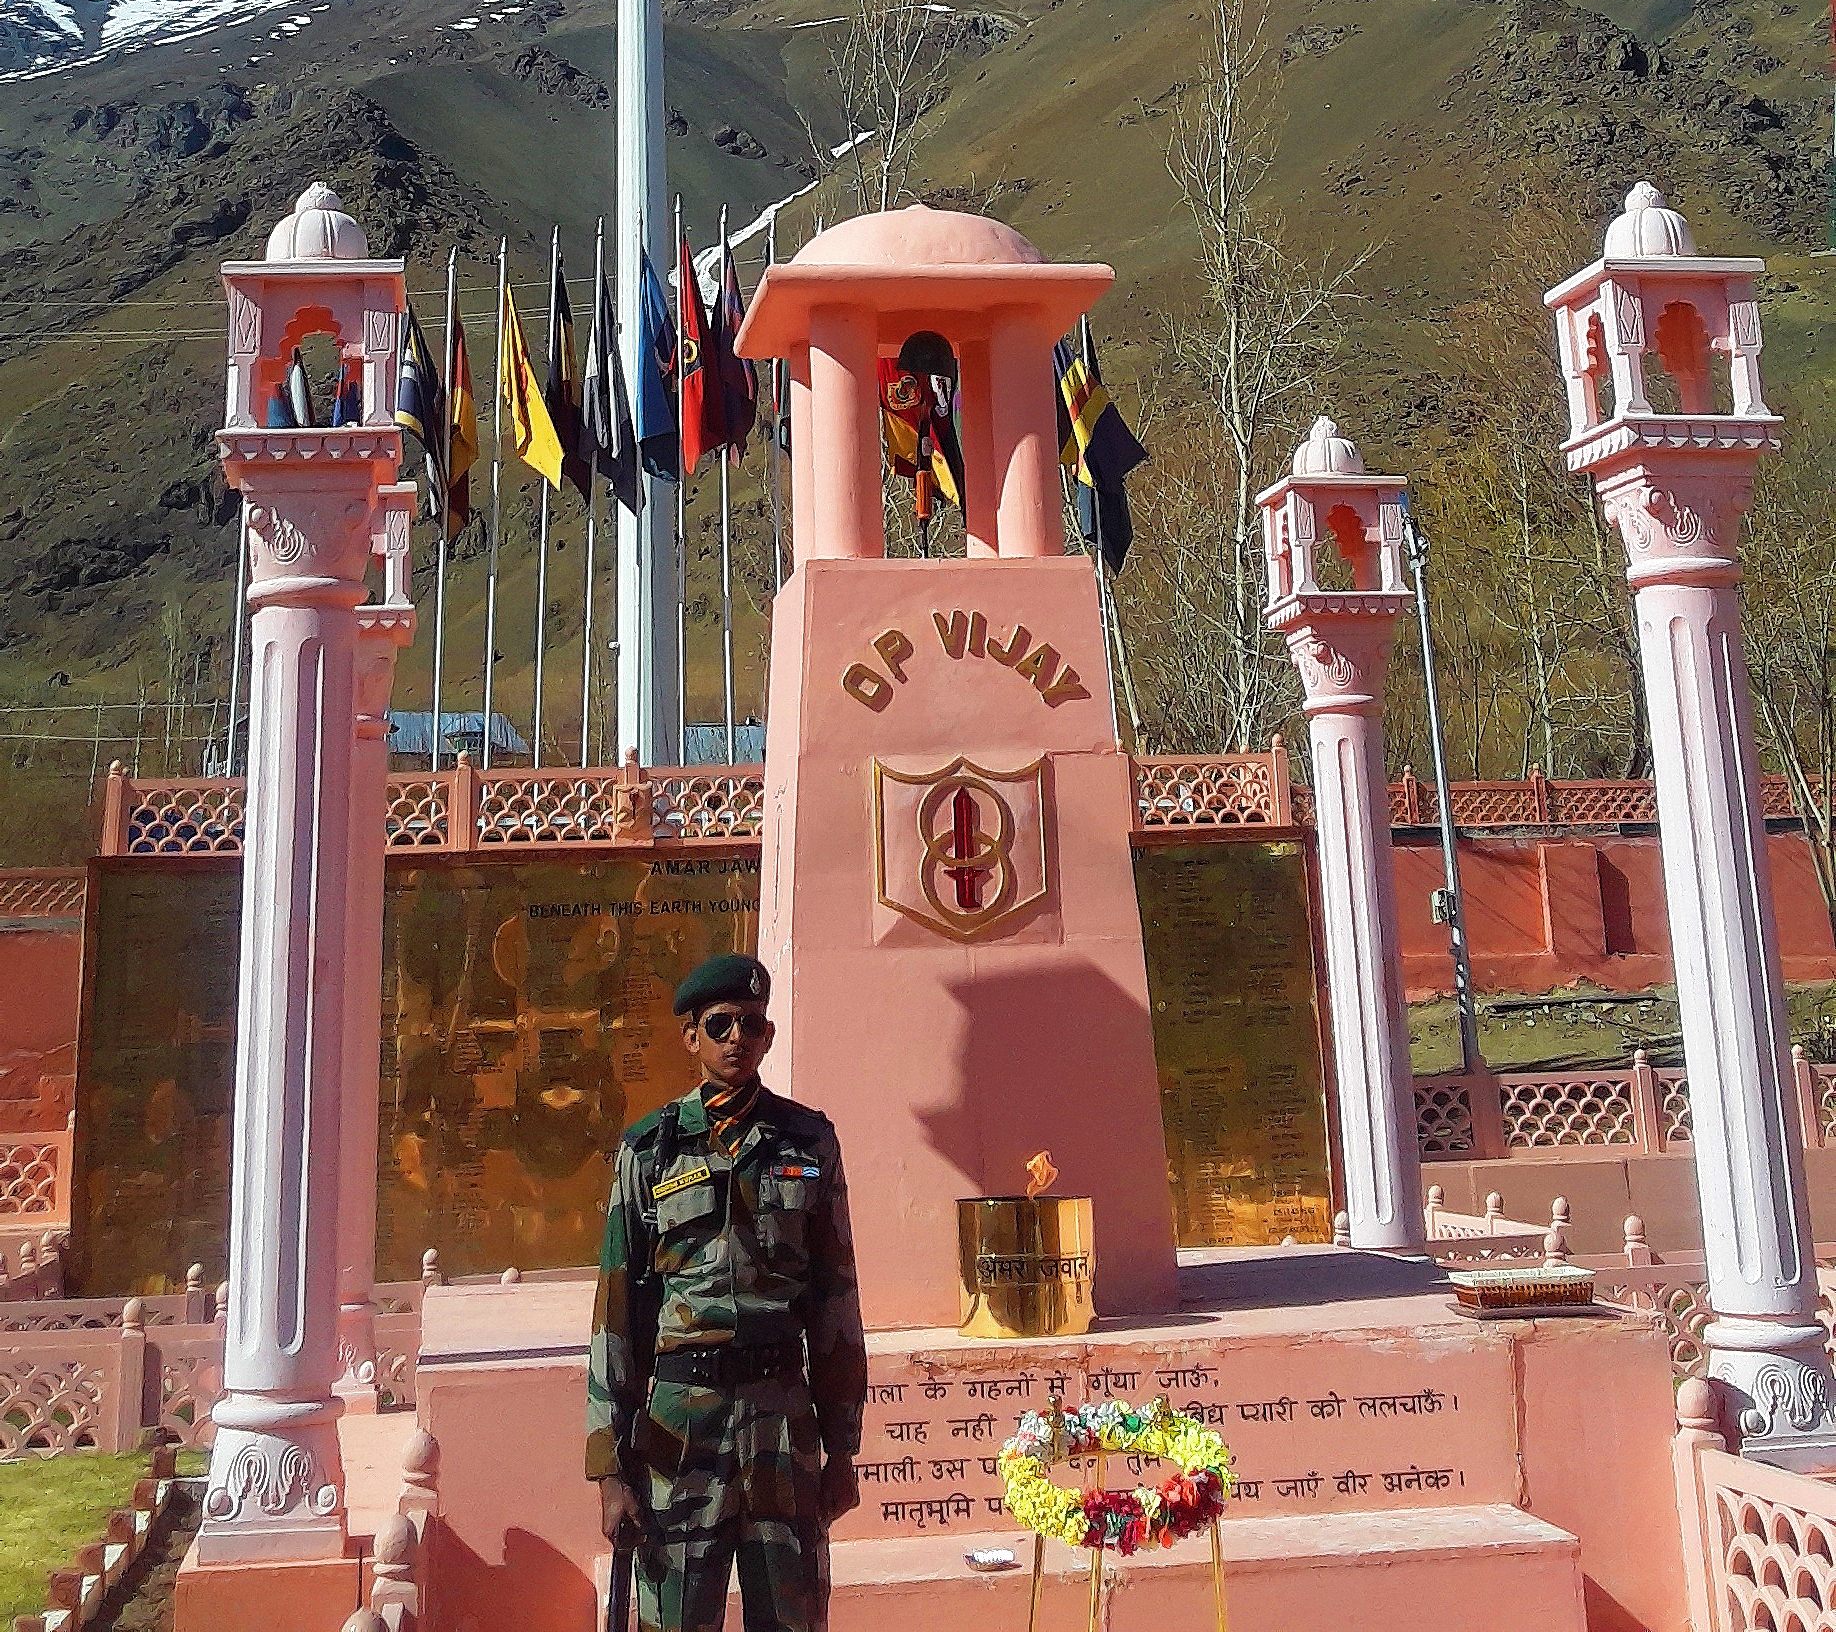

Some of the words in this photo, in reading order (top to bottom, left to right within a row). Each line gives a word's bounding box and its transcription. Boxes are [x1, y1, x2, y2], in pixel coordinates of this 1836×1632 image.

[843, 628, 914, 713] OP
[932, 609, 1092, 709] VIJAY
[651, 858, 710, 876] AMAR
[529, 902, 601, 919] BENEATH
[608, 900, 643, 917] THIS
[650, 899, 702, 915] EARTH
[1039, 1253, 1090, 1279] जवान
[917, 1372, 954, 1400] के
[962, 1371, 1038, 1400] गहनों
[1044, 1371, 1072, 1395] में
[885, 1419, 931, 1444] चाह
[946, 1412, 998, 1443] नहीं
[1236, 1395, 1298, 1423] प्यारी
[1306, 1390, 1347, 1420] को
[928, 1457, 971, 1482] उस
[880, 1491, 976, 1529] मातृभूमि
[1332, 1469, 1374, 1497] वीर
